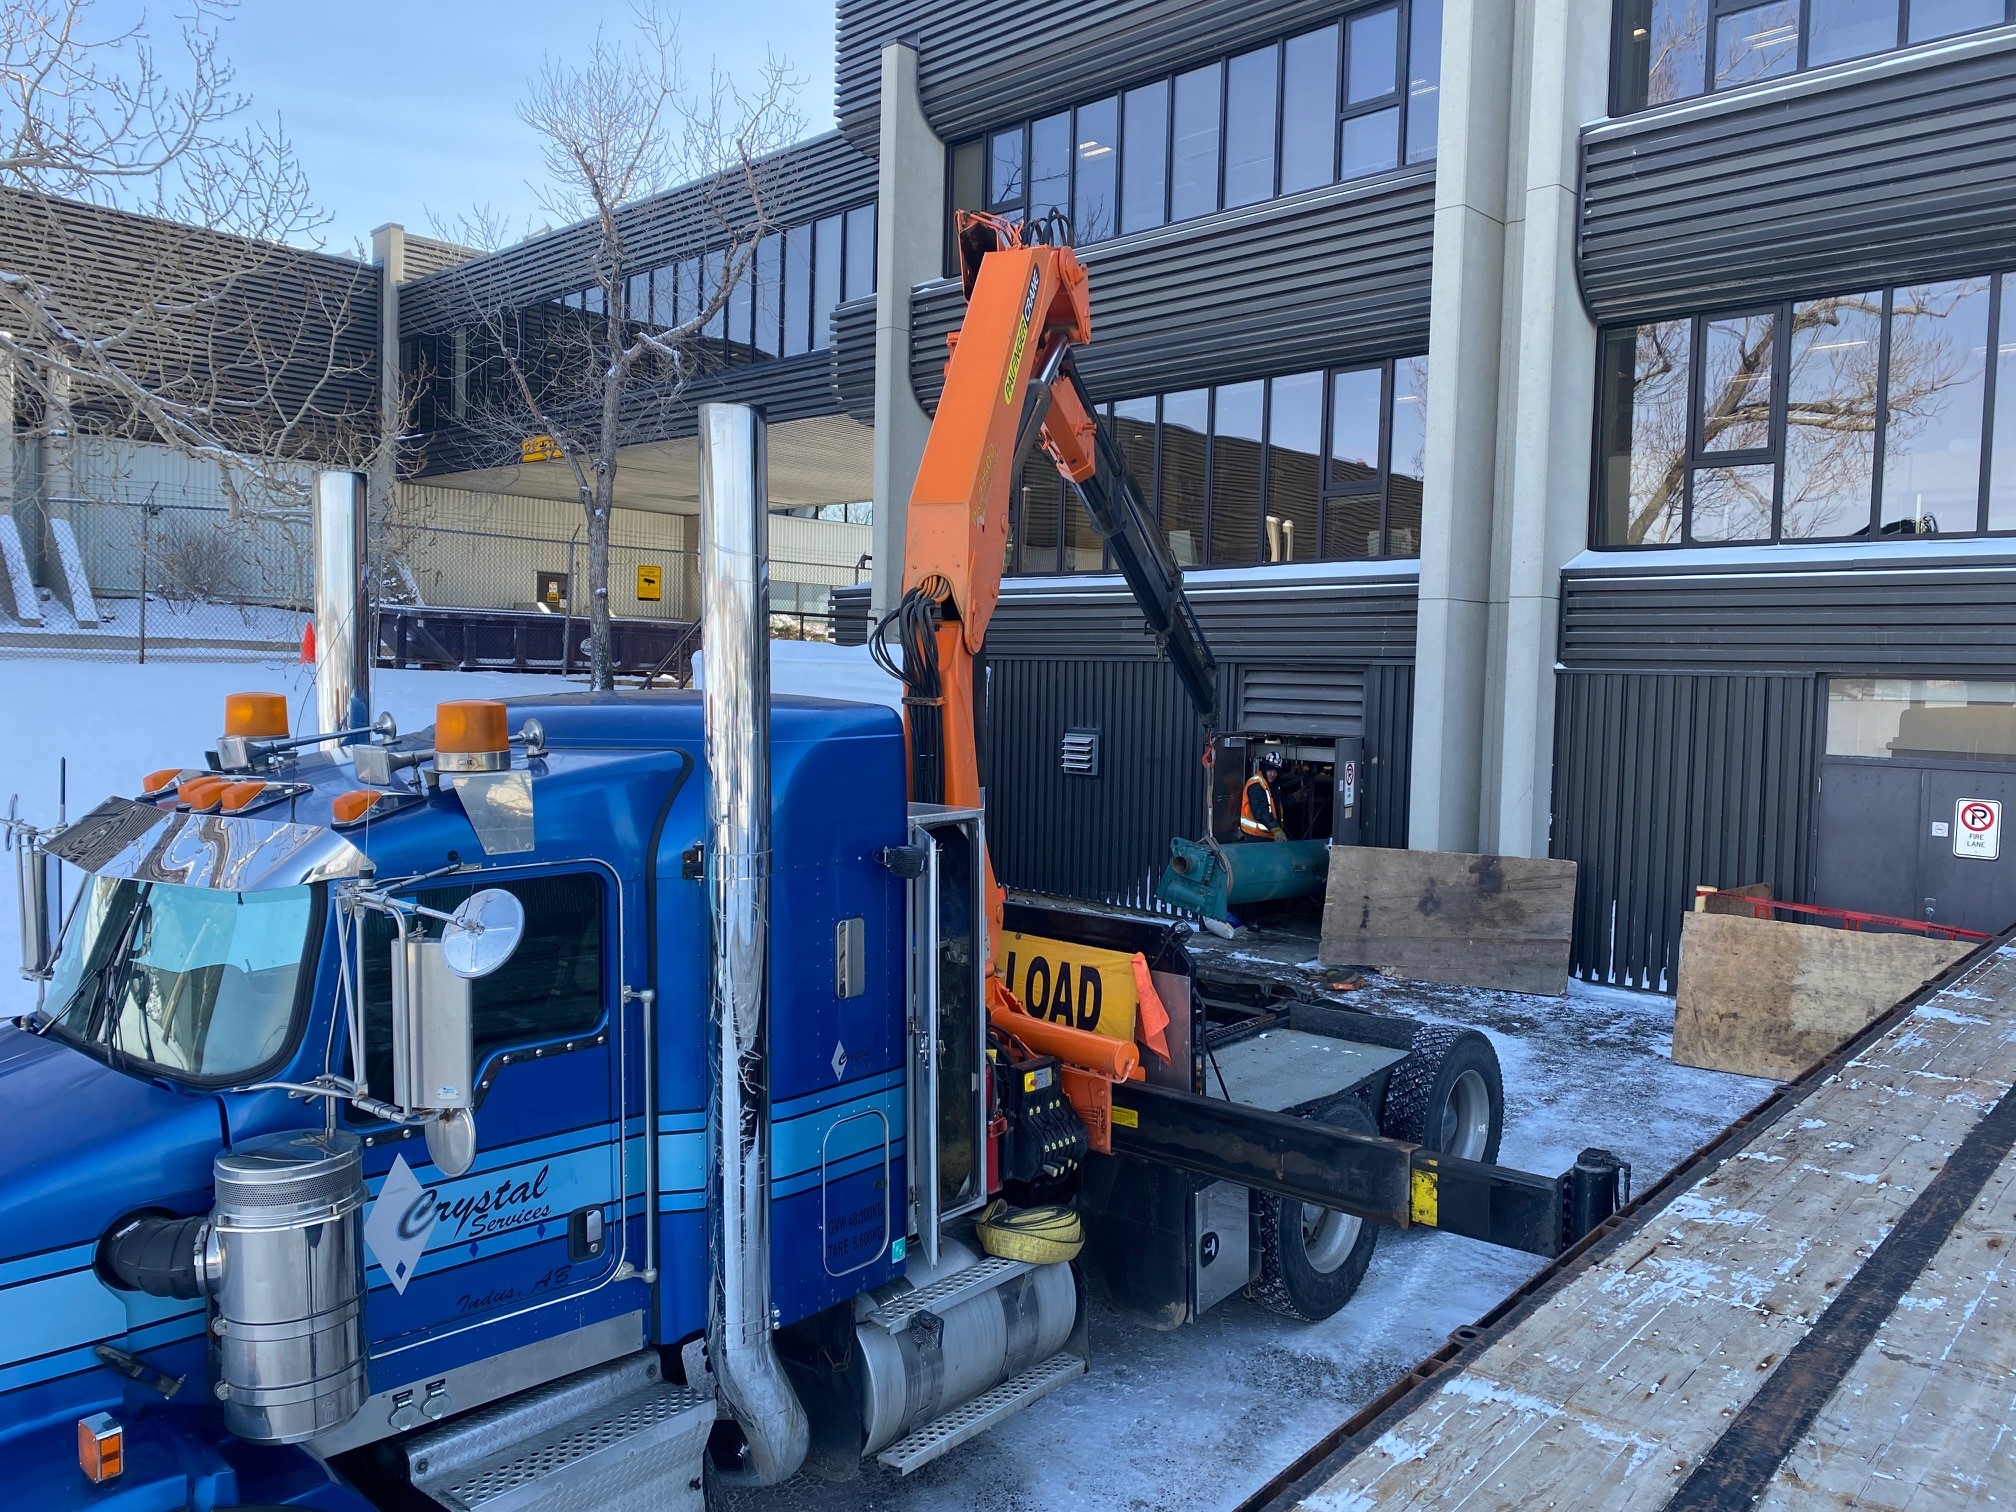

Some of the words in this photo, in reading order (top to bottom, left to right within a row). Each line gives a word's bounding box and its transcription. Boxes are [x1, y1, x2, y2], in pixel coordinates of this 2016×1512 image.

[1025, 270, 1039, 322] CRANE
[396, 1164, 549, 1241] Crystal
[468, 1204, 551, 1238] Services
[828, 1215, 847, 1236] GVW
[828, 1238, 848, 1259] TARE
[455, 1288, 523, 1314] Indus,
[531, 1264, 572, 1293] AB
